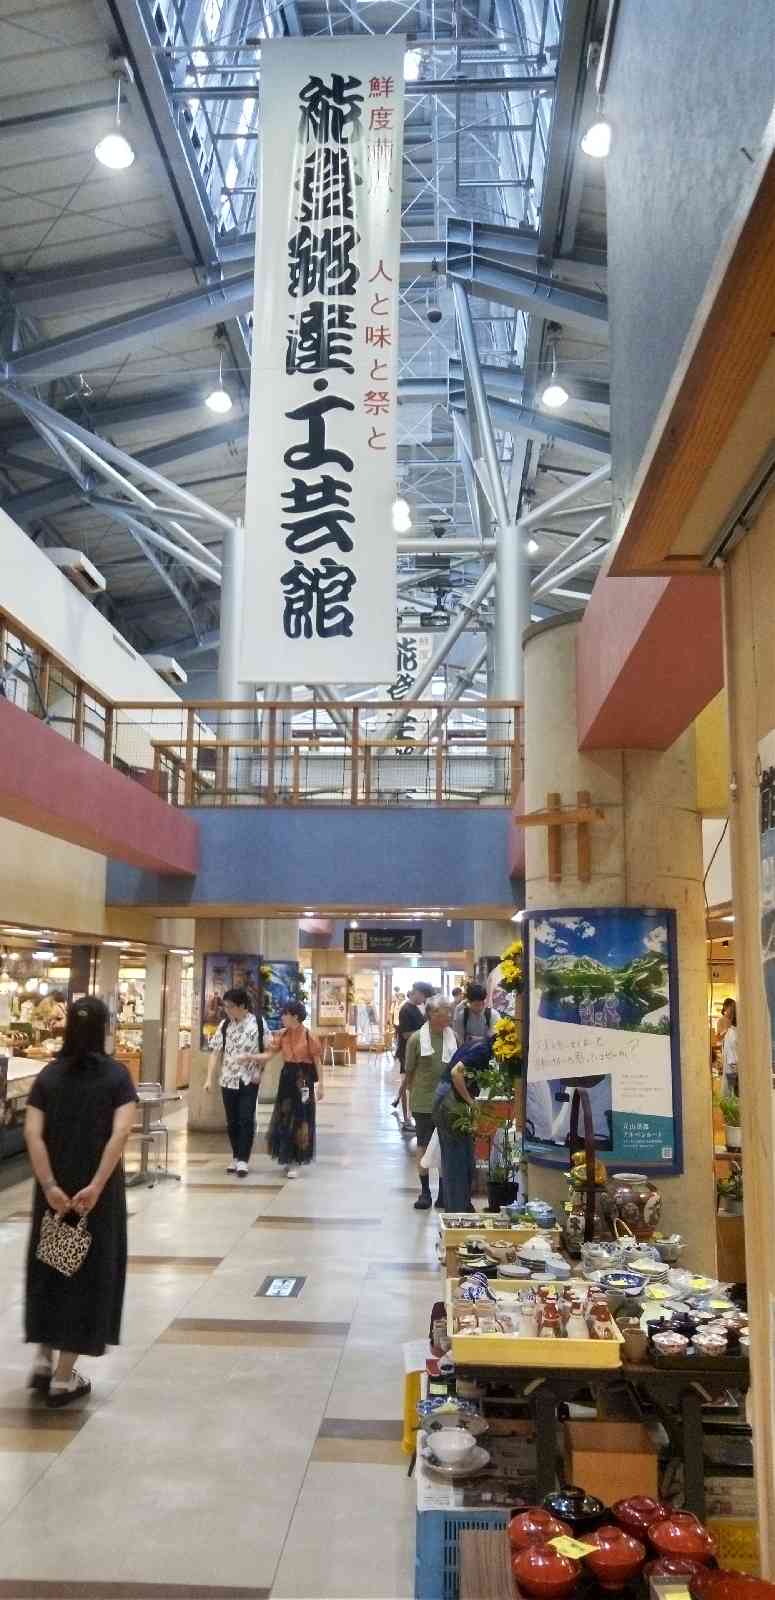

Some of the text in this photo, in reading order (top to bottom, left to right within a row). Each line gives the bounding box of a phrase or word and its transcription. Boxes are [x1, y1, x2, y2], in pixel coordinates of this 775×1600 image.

[365, 259, 393, 450] 人と味と祭と
